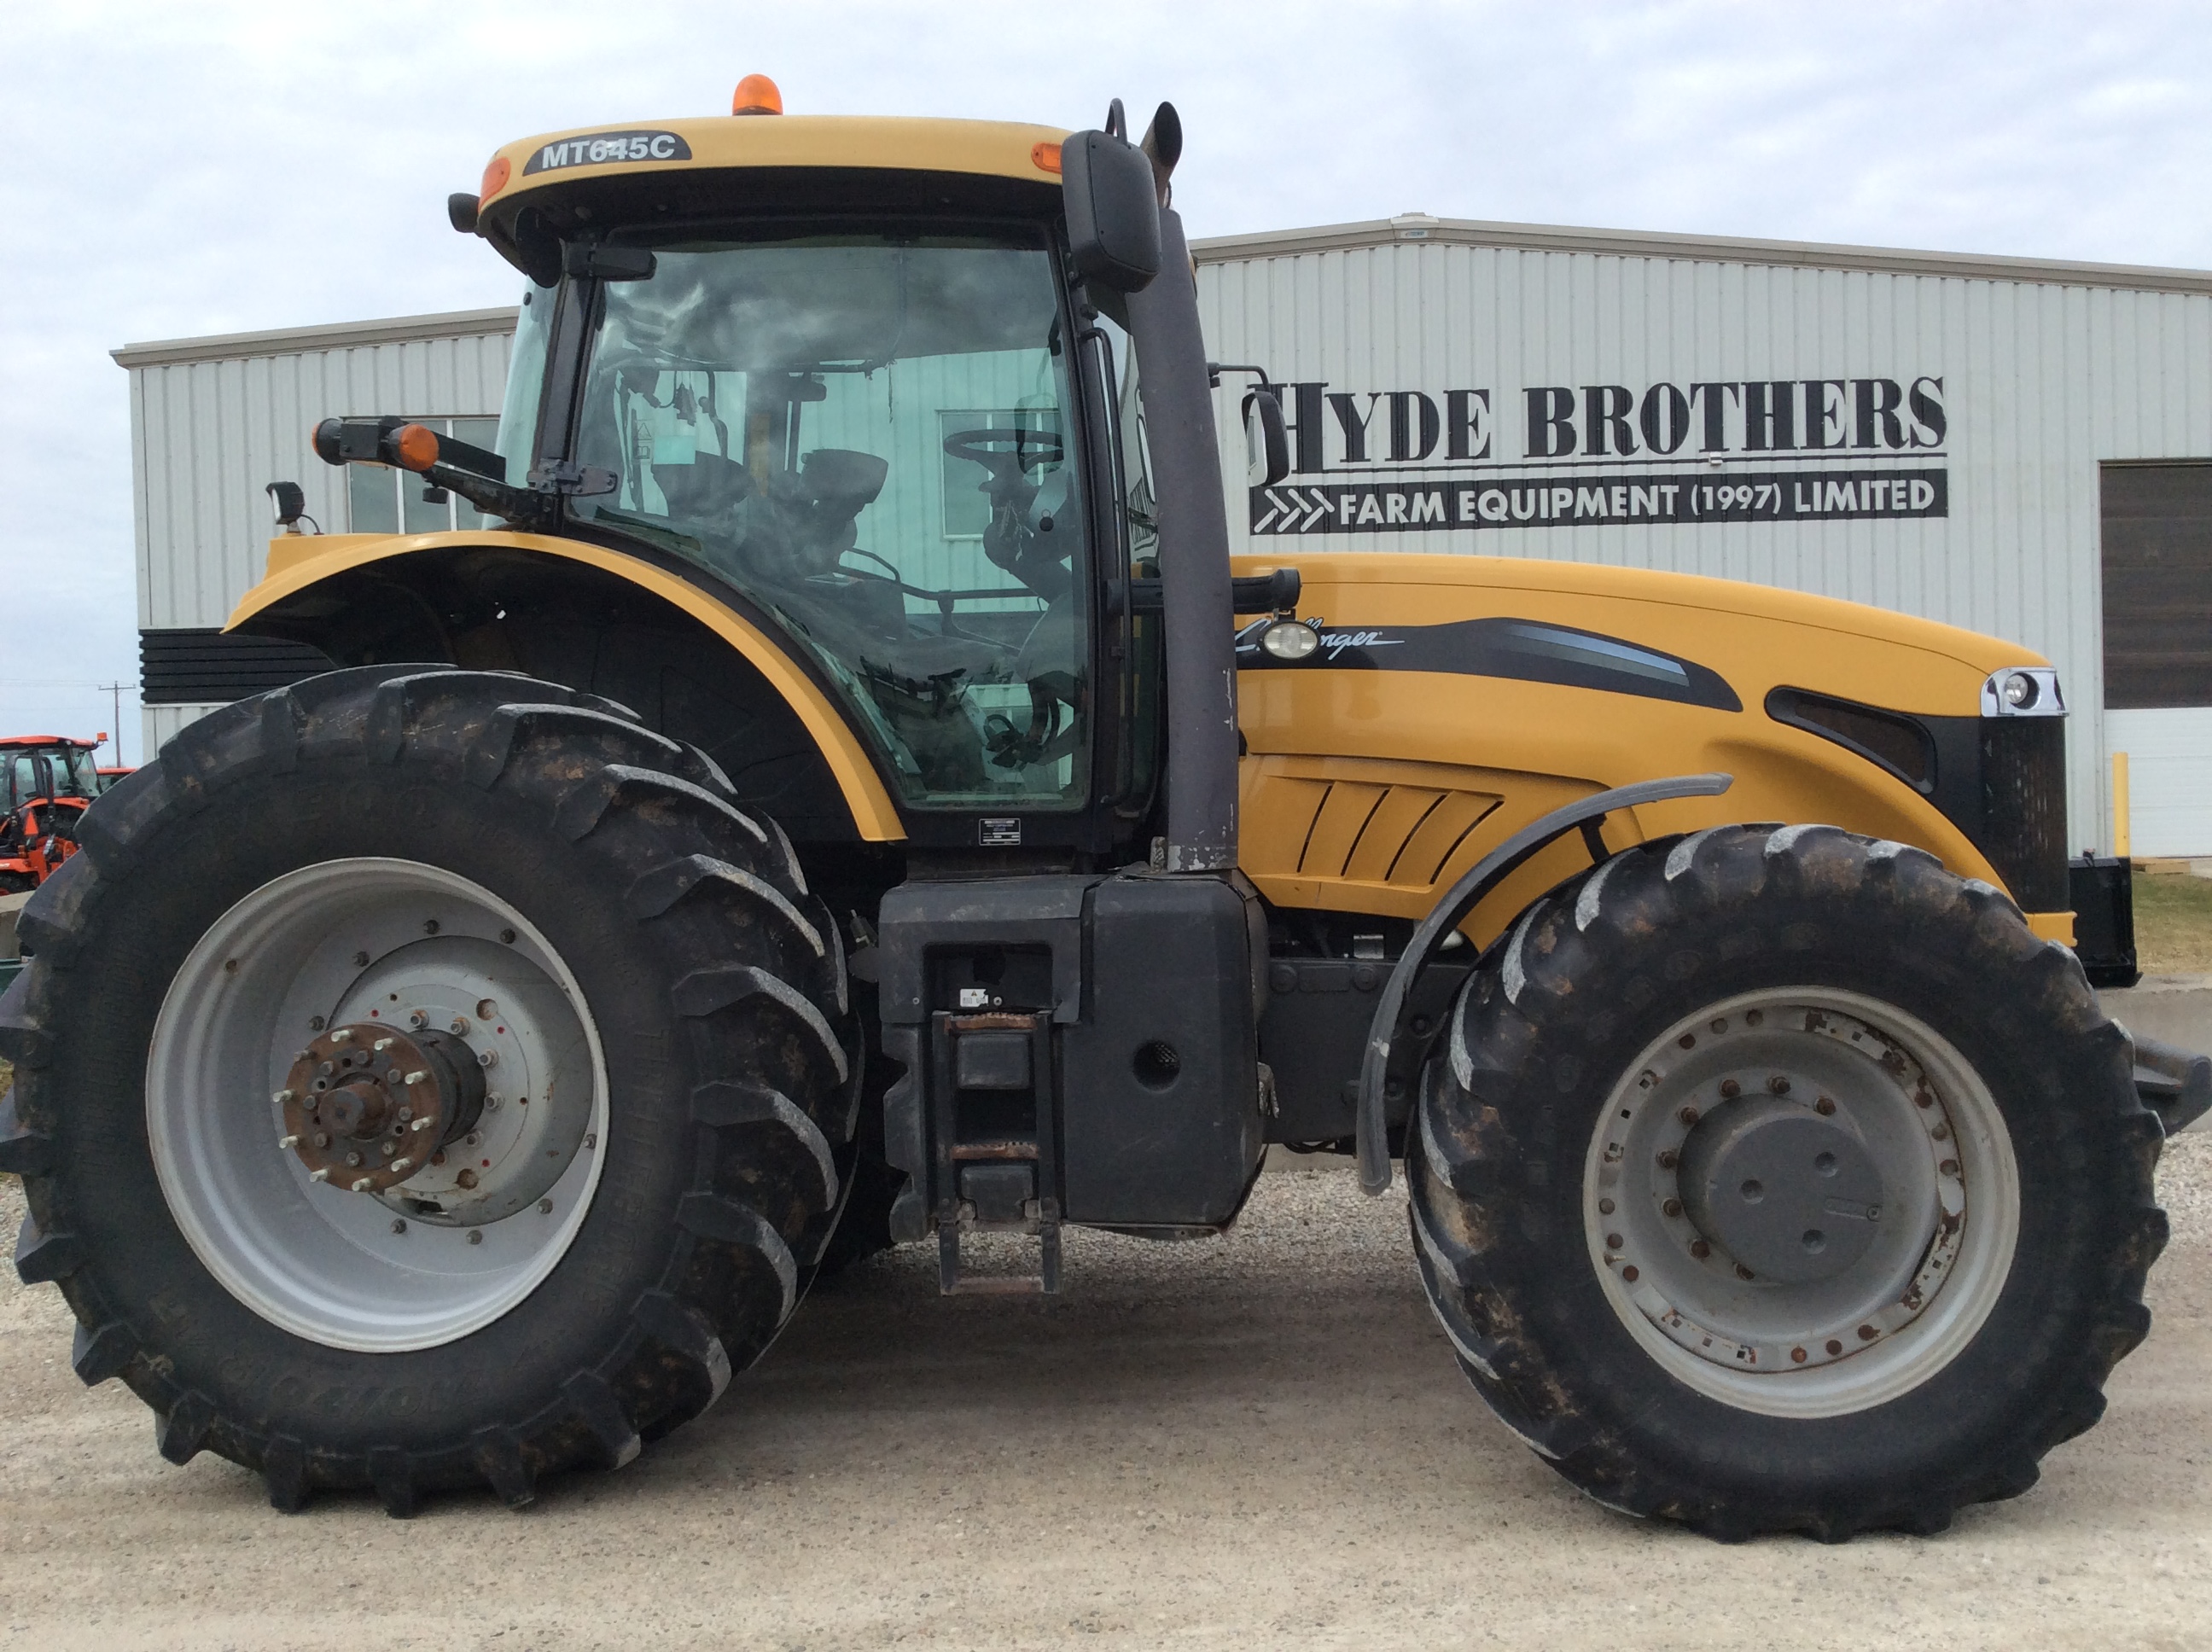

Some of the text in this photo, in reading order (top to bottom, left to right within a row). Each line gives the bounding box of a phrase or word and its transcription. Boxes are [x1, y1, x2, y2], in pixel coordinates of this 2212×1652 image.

[542, 135, 676, 168] MT645C
[1247, 375, 1947, 474] HYDE BROTHERS
[1340, 480, 1935, 526] FARM EQUIPMENT (1997) LIMITED
